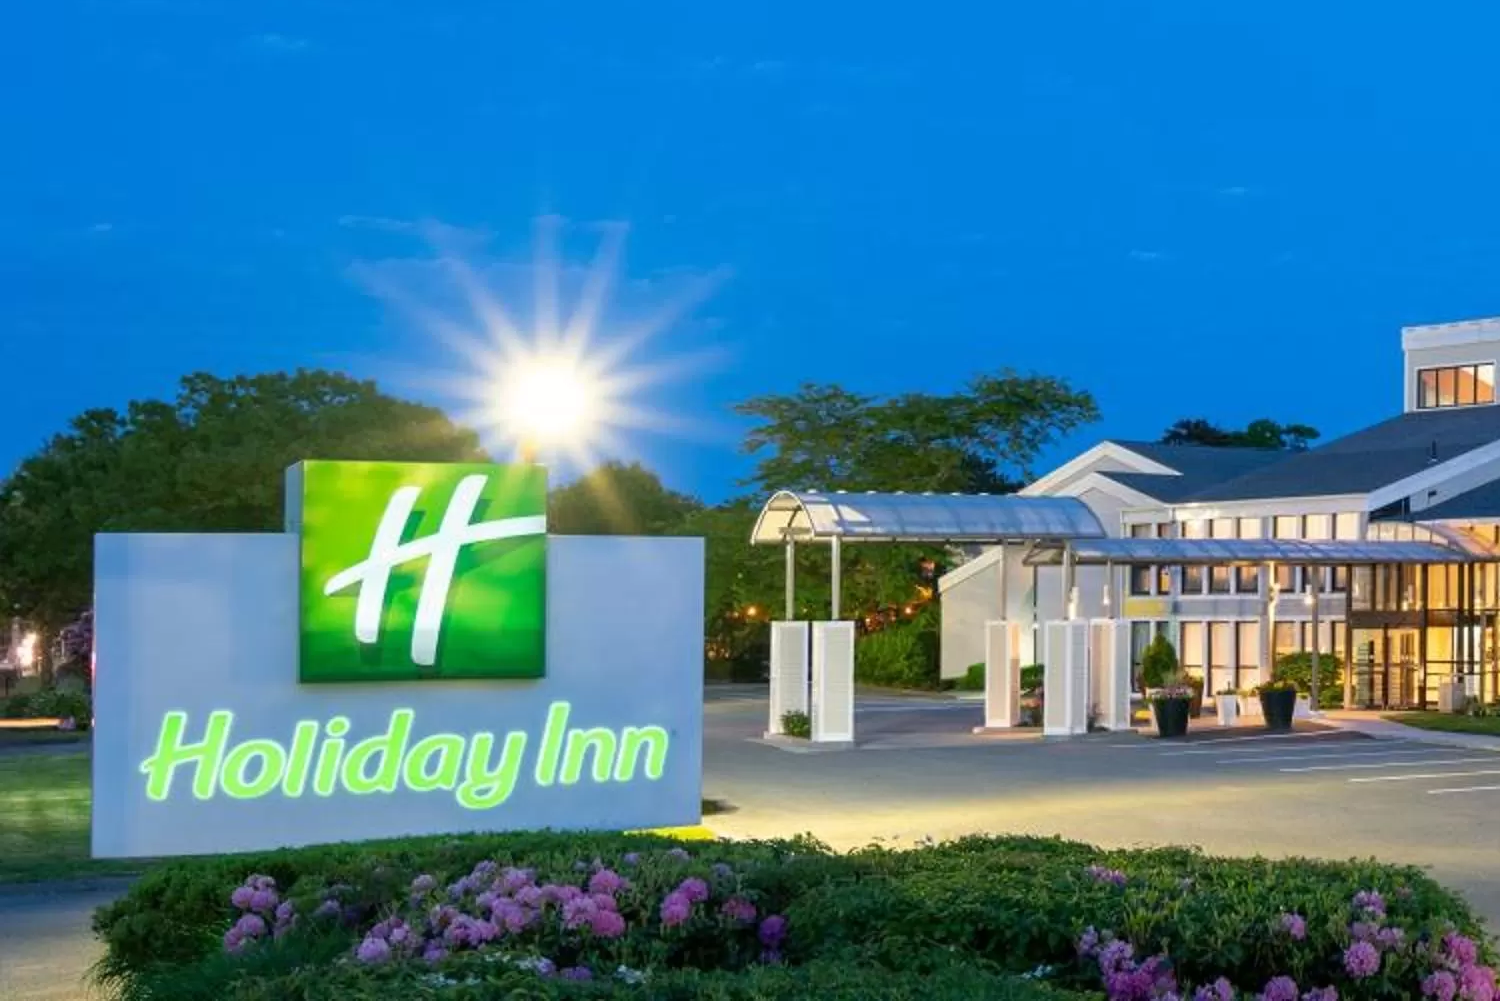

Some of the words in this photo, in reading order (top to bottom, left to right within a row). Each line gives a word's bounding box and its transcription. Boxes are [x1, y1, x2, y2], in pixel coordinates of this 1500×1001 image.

[324, 474, 546, 666] H
[139, 708, 527, 809] Holiday
[535, 701, 669, 786] Inn
